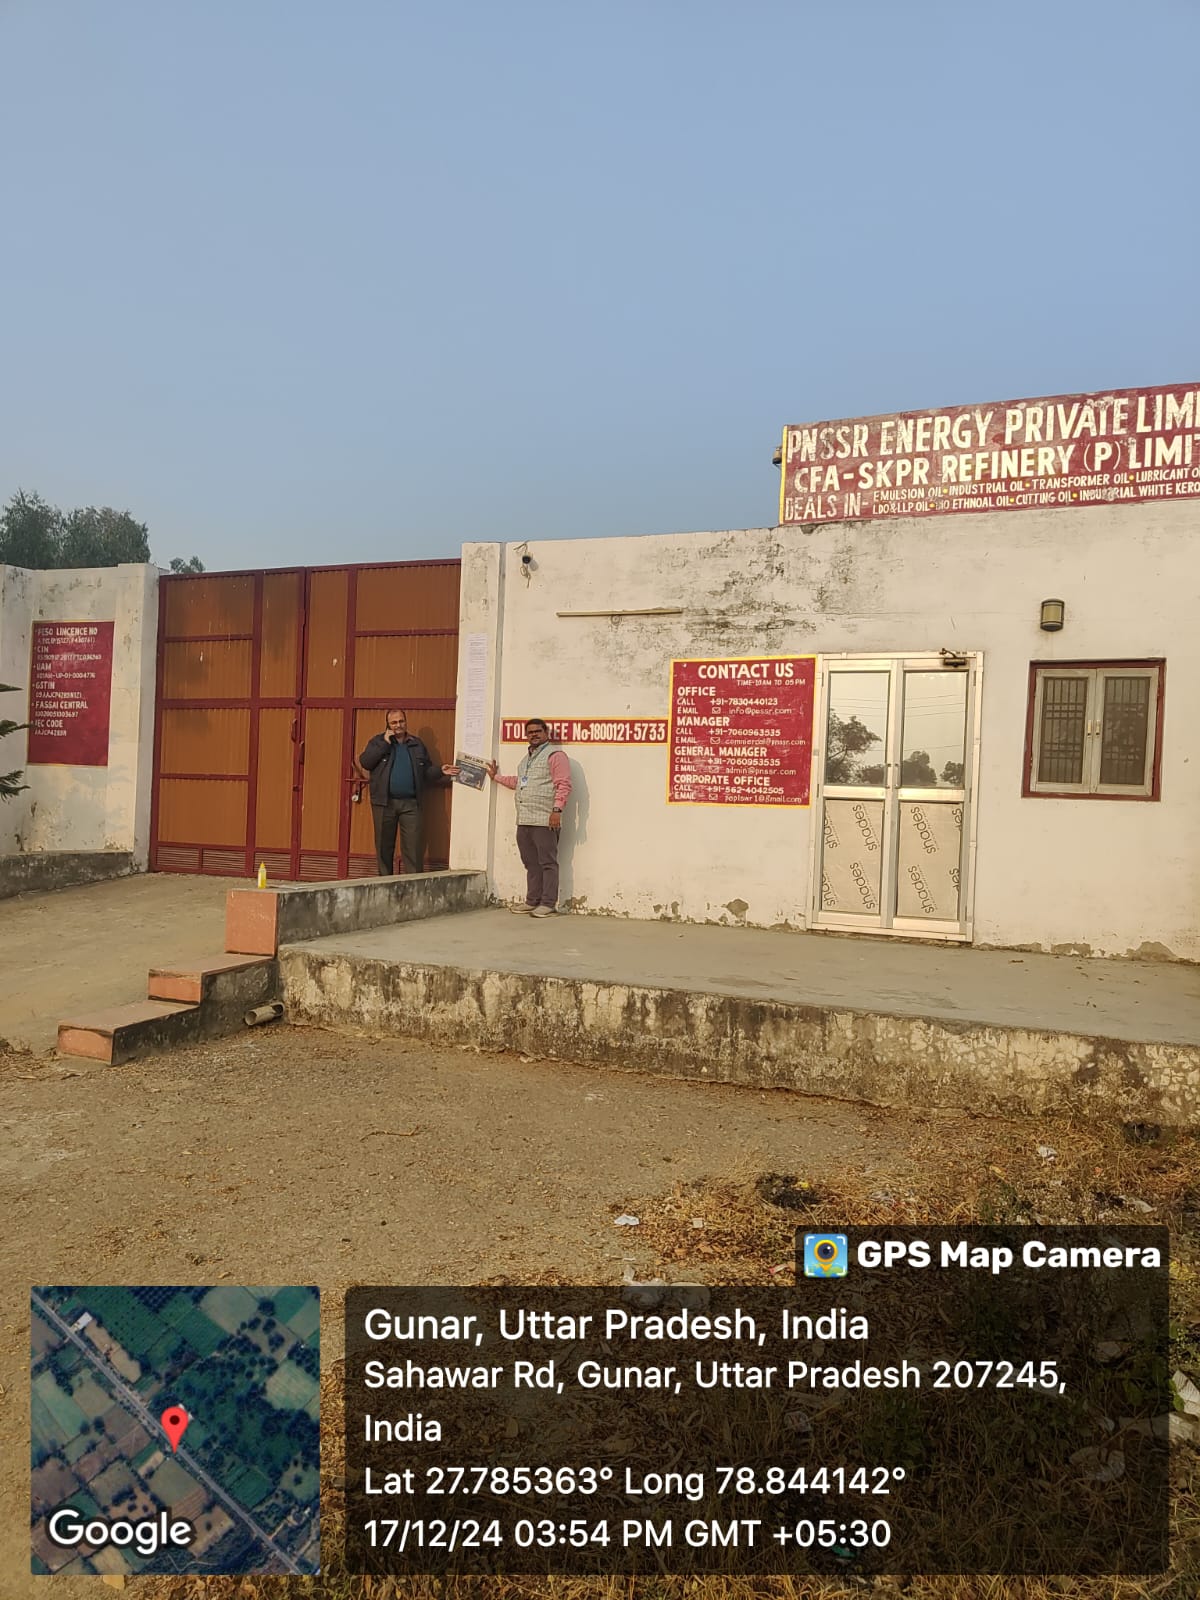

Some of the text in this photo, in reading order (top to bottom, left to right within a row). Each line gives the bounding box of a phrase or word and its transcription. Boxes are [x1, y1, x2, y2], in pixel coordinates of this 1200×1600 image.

[786, 424, 869, 464] PNSSR
[879, 411, 994, 456] ENERGY
[1004, 397, 1129, 445] PRIVATE
[941, 444, 1075, 483] REFINERY
[1083, 440, 1121, 473] (P)
[873, 487, 925, 503] EMULSION
[928, 486, 944, 499] OIL
[949, 482, 1008, 496] INDUSTRIAL
[1009, 480, 1025, 493] OIL
[1031, 474, 1110, 490] TRANSFORMER
[1113, 473, 1130, 485] OIL
[1136, 467, 1190, 483] LUBRICANT
[915, 501, 930, 512] OIL
[952, 495, 995, 510] ETHNOAL
[996, 495, 1011, 507] OIL
[1016, 491, 1056, 506] CUTTING
[1057, 490, 1074, 503] OIL
[1138, 482, 1174, 497] WHITE
[784, 494, 838, 521] DEALS
[36, 662, 52, 671] UAM
[698, 662, 794, 679] CONTACT US
[35, 681, 56, 690] GSTIN
[795, 678, 806, 686] PM
[677, 686, 716, 697] OFFICE
[60, 700, 89, 710] CENTRAL
[677, 698, 696, 706] CALL
[46, 719, 64, 728] CODE
[676, 716, 730, 727] MANAGER
[675, 727, 693, 736] CALL
[674, 746, 768, 758] GENERAL MANAGER
[673, 774, 770, 787] CORPORATE OFFICE
[673, 784, 693, 792] CALL
[852, 804, 878, 851] shades
[911, 806, 937, 854] shades
[849, 862, 876, 910] shades
[908, 865, 936, 914] shades
